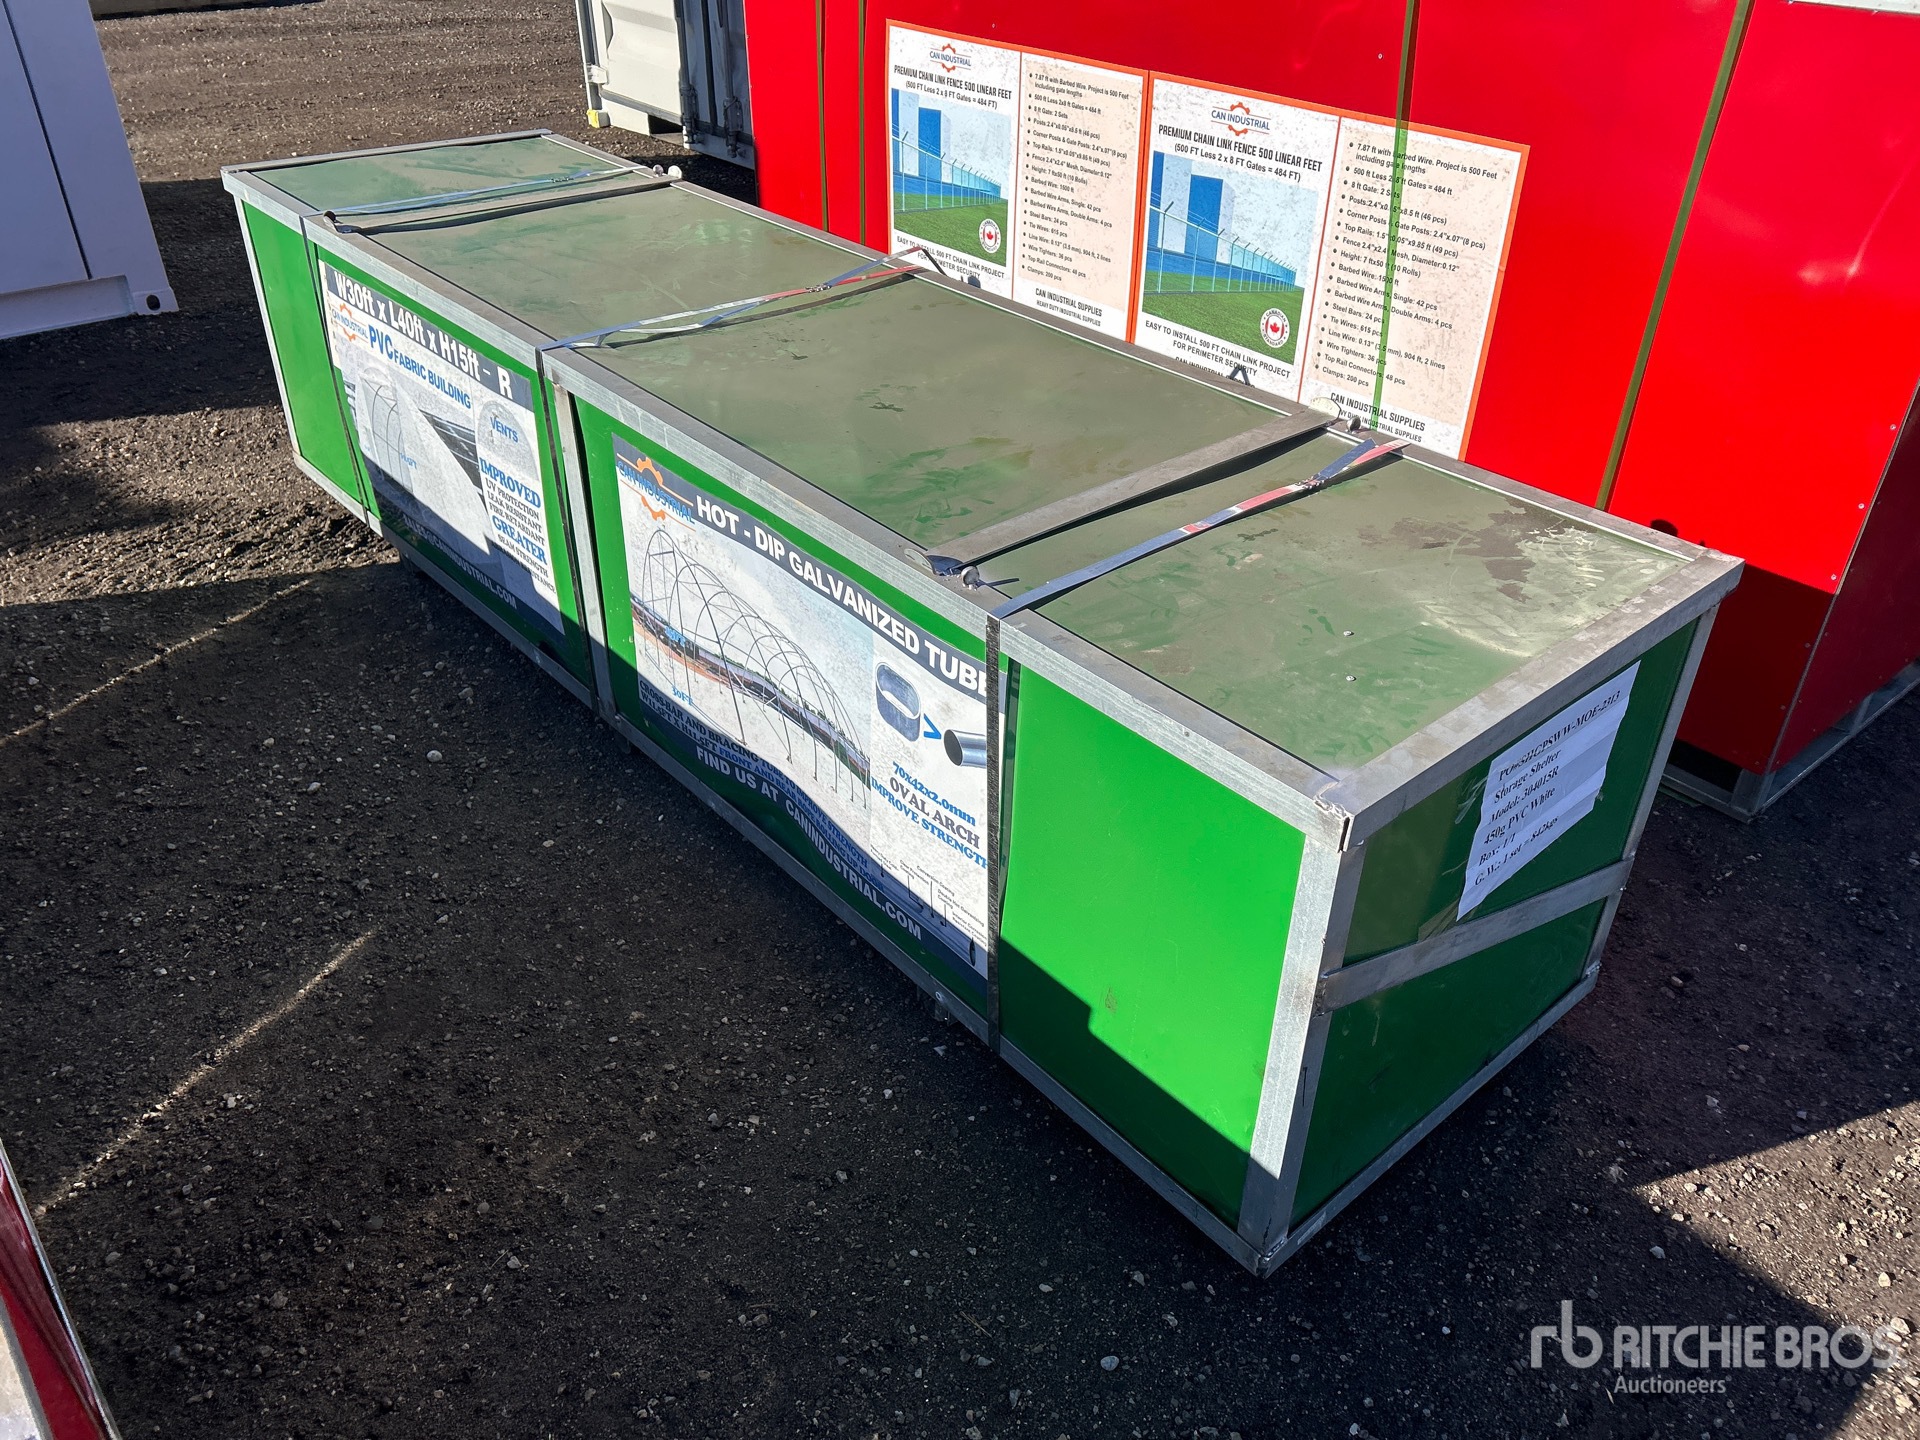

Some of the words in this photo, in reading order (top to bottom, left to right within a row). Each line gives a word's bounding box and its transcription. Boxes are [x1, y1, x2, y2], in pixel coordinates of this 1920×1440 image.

[930, 51, 940, 60] CAN
[941, 54, 971, 66] INDUSTRIAL
[894, 65, 917, 78] PREMIUM
[919, 71, 933, 82] CHAIN
[935, 75, 946, 85] LINK
[947, 77, 963, 89] FENCE
[965, 82, 975, 92] 500
[977, 84, 996, 96] LINEAR
[998, 88, 1012, 100] FEET
[1211, 110, 1226, 120] CAN
[1227, 114, 1270, 130] INDUSTRIAL
[1158, 124, 1192, 141] PREMIUM
[1194, 132, 1215, 146] CHAIN
[1216, 137, 1232, 150] LINK
[1234, 142, 1257, 156] FENCE
[1259, 148, 1273, 160] 500
[1275, 151, 1301, 167] LINEAR
[1303, 158, 1322, 172] FEET
[1175, 143, 1188, 153] (500
[1190, 146, 1199, 155] FT
[1201, 151, 1216, 160] Less
[1230, 156, 1234, 164] 8
[1236, 157, 1244, 166] FT
[1246, 161, 1266, 172] Gates
[1274, 168, 1287, 177] 484
[1289, 171, 1301, 181] FT)
[1036, 288, 1045, 298] CAN
[1048, 292, 1076, 308] INDUSTRIAL
[1078, 302, 1102, 317] SUPPLIES
[1335, 291, 1356, 301] Barbed
[1357, 297, 1370, 306] Wire
[1391, 307, 1413, 318] Double
[1414, 314, 1433, 324] Arms:
[1440, 322, 1452, 330] pcs
[334, 272, 373, 316] W30ft
[377, 300, 388, 323] x
[389, 300, 426, 347] L40ft
[428, 330, 438, 352] x
[438, 326, 480, 381] H15ft
[497, 366, 512, 400] R
[341, 314, 368, 339] INDUSTRIAL
[368, 324, 393, 360] PVC
[394, 348, 427, 380] FABRIC
[428, 370, 472, 409] BUILDING
[1146, 320, 1161, 331] EASY
[1162, 326, 1171, 335] TO
[1173, 330, 1198, 344] INSTALL
[1200, 339, 1210, 349] 500
[1212, 343, 1219, 352] FT
[1221, 347, 1241, 360] CHAIN
[1243, 355, 1257, 366] LINK
[1259, 361, 1290, 378] PROJECT
[1173, 340, 1186, 350] FOR
[1188, 345, 1224, 364] PERIMETER
[1225, 358, 1257, 376] SECURITY
[1327, 342, 1340, 350] Wire
[1341, 346, 1366, 359] Tighters:
[1376, 358, 1386, 367] pcs
[1322, 367, 1346, 379] Clamps:
[1347, 374, 1357, 383] 200
[490, 417, 519, 443] VENTS
[1330, 392, 1344, 407] CAN
[1346, 398, 1388, 419] INDUSTRIAL
[1390, 412, 1425, 431] SUPPLIES
[479, 457, 541, 508] IMPROVED
[485, 478, 496, 490] UV
[498, 484, 539, 521] PROTECTION
[618, 460, 636, 482] CAN
[636, 474, 695, 524] INDUSTRIAL
[487, 490, 505, 508] LEAK
[505, 500, 542, 534] RESISTANT
[489, 502, 505, 518] FIRE
[505, 512, 545, 546] RETARDANT
[492, 515, 547, 565] GREATER
[498, 534, 515, 553] SEAM
[515, 548, 548, 578] STRENGTH
[697, 494, 740, 534] HOT
[754, 525, 786, 561] DIP
[788, 548, 920, 655] GALVANIZED
[640, 680, 684, 720] CROSS-BAR
[686, 716, 706, 736] AND
[708, 729, 758, 762] BRACING
[797, 787, 827, 824] IMPROVE
[828, 820, 868, 867] STRENGTH
[674, 717, 680, 726] X
[720, 747, 752, 770] FRONT
[755, 765, 774, 783] AND
[776, 780, 796, 801] REAR
[847, 850, 857, 868] UP
[893, 761, 976, 826] 70x42x2.0mm
[1489, 796, 1520, 825] Model:
[1521, 766, 1559, 800] 304015R
[1495, 773, 1528, 804] Storage
[1529, 749, 1562, 777] Shelter
[871, 776, 919, 824] IMPROVE
[890, 777, 929, 816] OVAL
[932, 810, 980, 849] ARCH
[1484, 824, 1506, 845] 450g
[1508, 805, 1529, 829] PVC
[1530, 788, 1556, 810] White
[696, 746, 731, 775] FIND
[735, 767, 756, 789] US
[761, 781, 779, 802] AT
[786, 800, 921, 940] CANINDUSTRIAL.COM
[1479, 846, 1500, 866] Box:
[1503, 833, 1516, 848] 1/1
[1510, 844, 1523, 857] set
